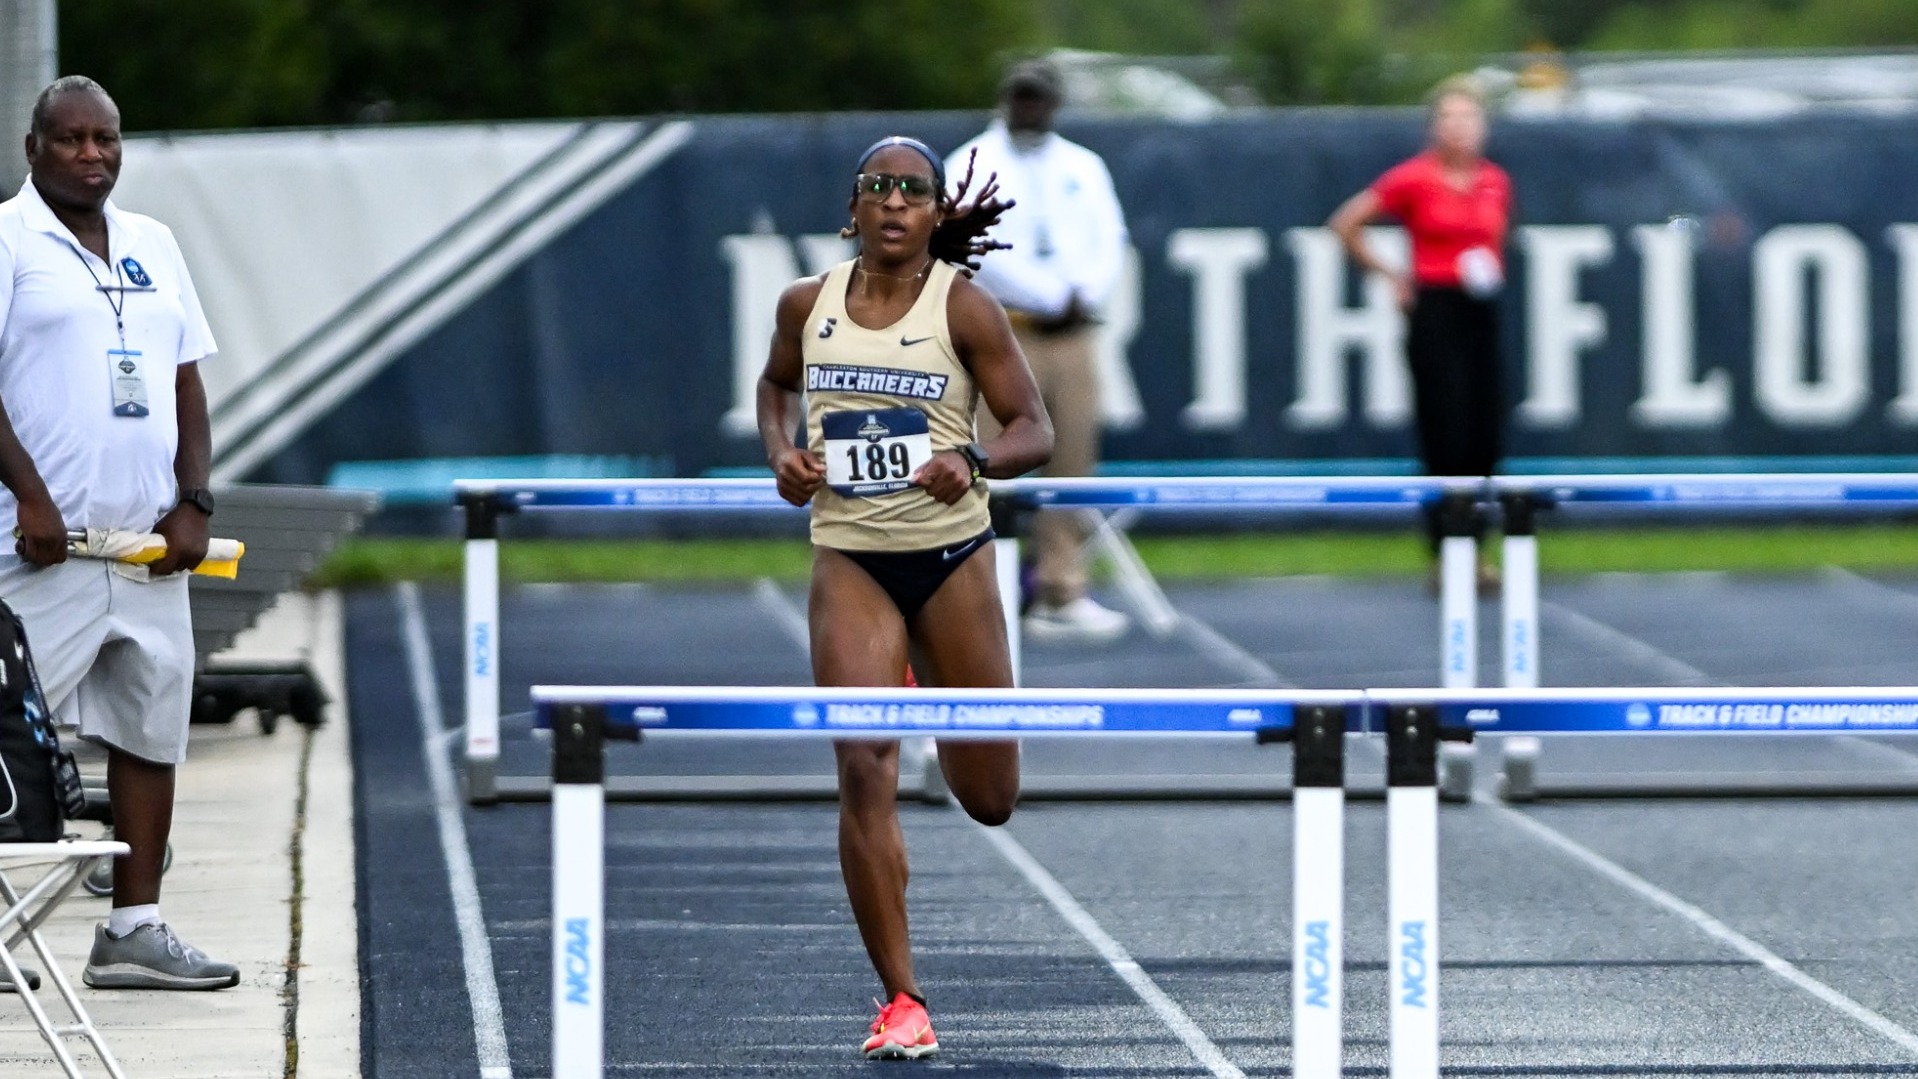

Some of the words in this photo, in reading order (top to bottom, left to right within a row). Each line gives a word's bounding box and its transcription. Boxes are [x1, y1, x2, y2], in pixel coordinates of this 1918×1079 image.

[1512, 223, 1918, 430] FLO
[807, 364, 948, 400] BUCCANEERS
[846, 441, 910, 481] 189
[827, 703, 885, 725] TRACK
[900, 703, 951, 725] FIELD
[952, 703, 1105, 725] CHAMPIONSHIPS
[1658, 704, 1717, 725] TRACK
[1733, 704, 1784, 725] FIELD
[564, 917, 591, 1006] NCAA
[1304, 920, 1329, 1008] NCAA
[1401, 920, 1427, 1008] NCAA
